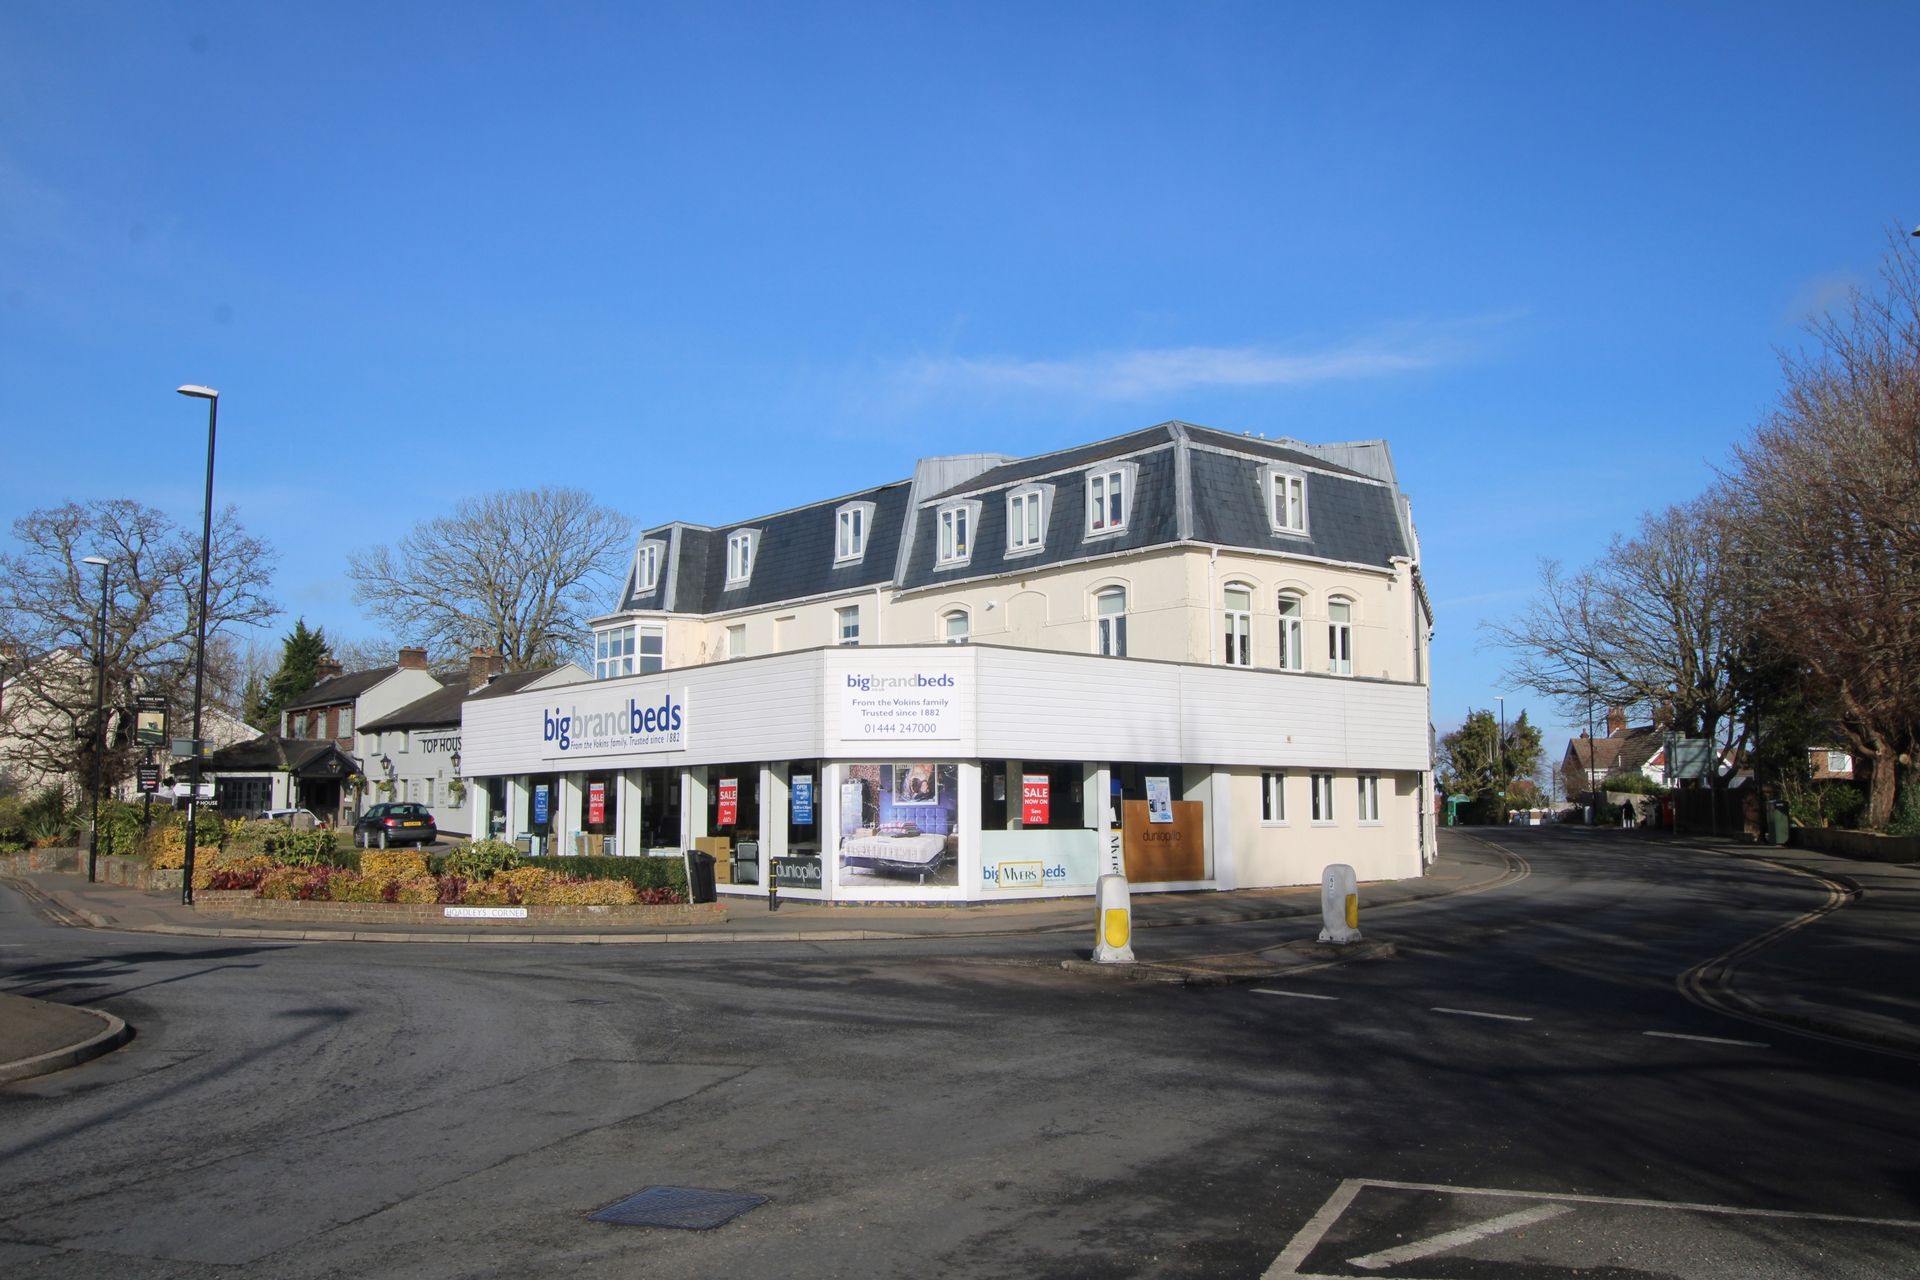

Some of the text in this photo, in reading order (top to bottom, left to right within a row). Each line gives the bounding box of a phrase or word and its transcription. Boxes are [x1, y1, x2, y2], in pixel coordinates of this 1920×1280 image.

[847, 673, 955, 692] bigbrandbeds
[852, 698, 949, 708] From the Vokins family
[861, 708, 940, 717] Trusted since 1882
[543, 694, 682, 750] bigbrandbeds
[864, 723, 937, 733] 01444 247000
[422, 736, 462, 753] TOP HOUS
[570, 741, 583, 750] From
[584, 740, 593, 749] the
[629, 736, 649, 746] Trusted
[650, 735, 665, 744] since
[666, 732, 680, 743] 1882
[590, 793, 604, 801] SALE
[720, 790, 736, 800] SALE
[1024, 788, 1048, 797] SALE
[776, 860, 821, 882] dunlopillo
[491, 908, 525, 917] CORNER
